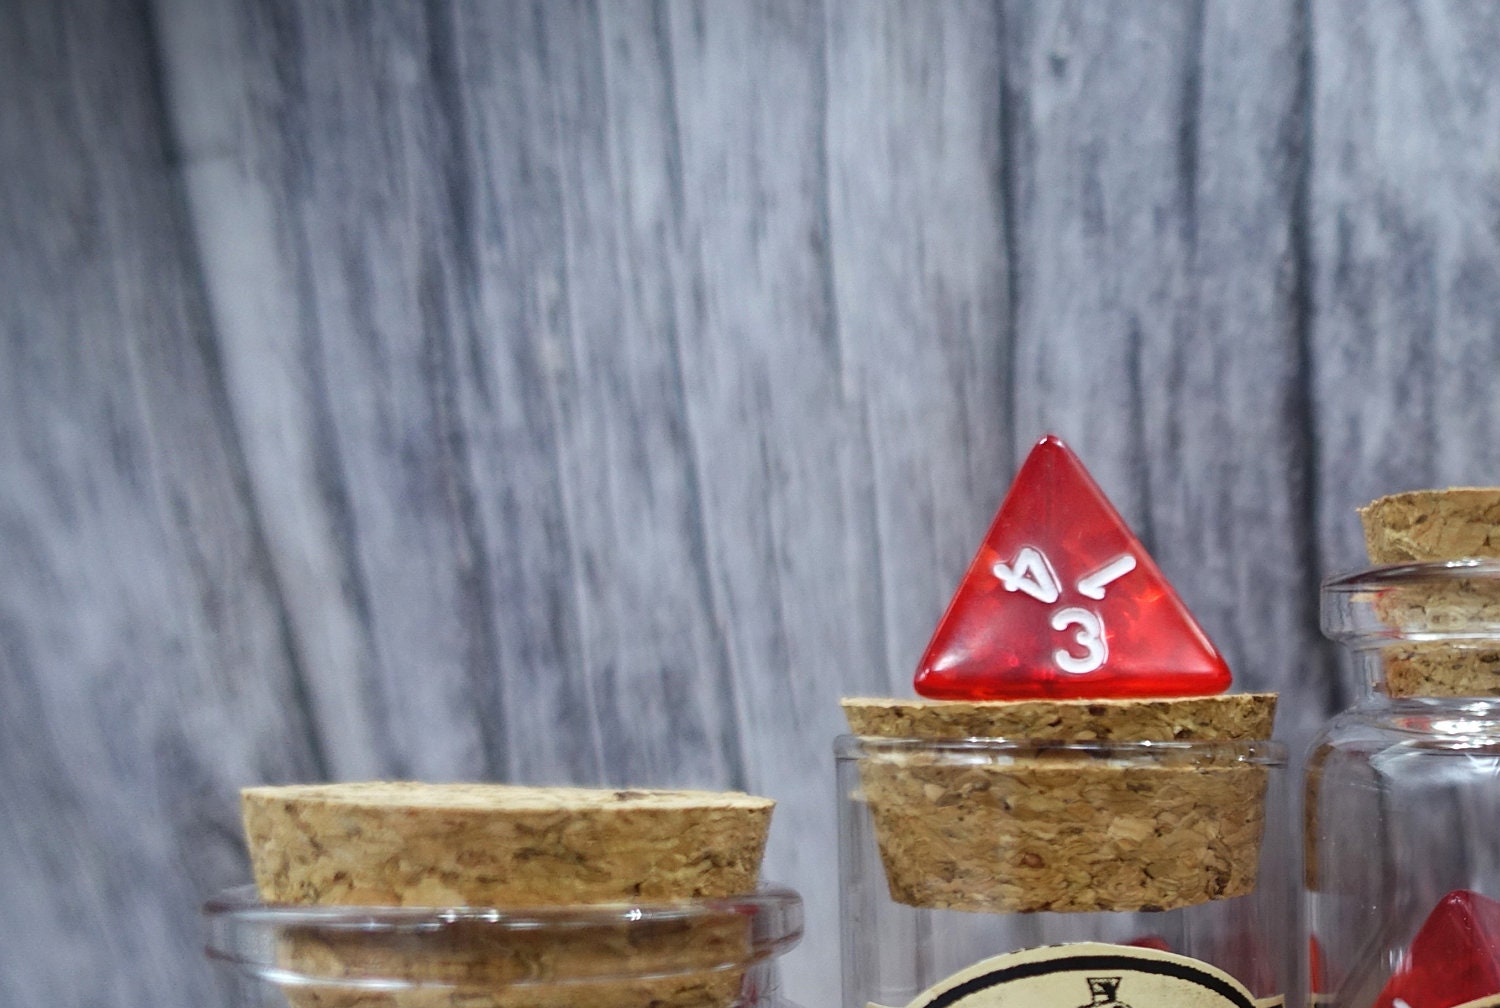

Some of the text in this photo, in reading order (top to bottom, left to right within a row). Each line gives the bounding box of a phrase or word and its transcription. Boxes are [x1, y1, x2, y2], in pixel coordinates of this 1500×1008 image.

[992, 547, 1063, 604] 4
[1077, 554, 1137, 600] 1
[1051, 607, 1109, 674] 3
